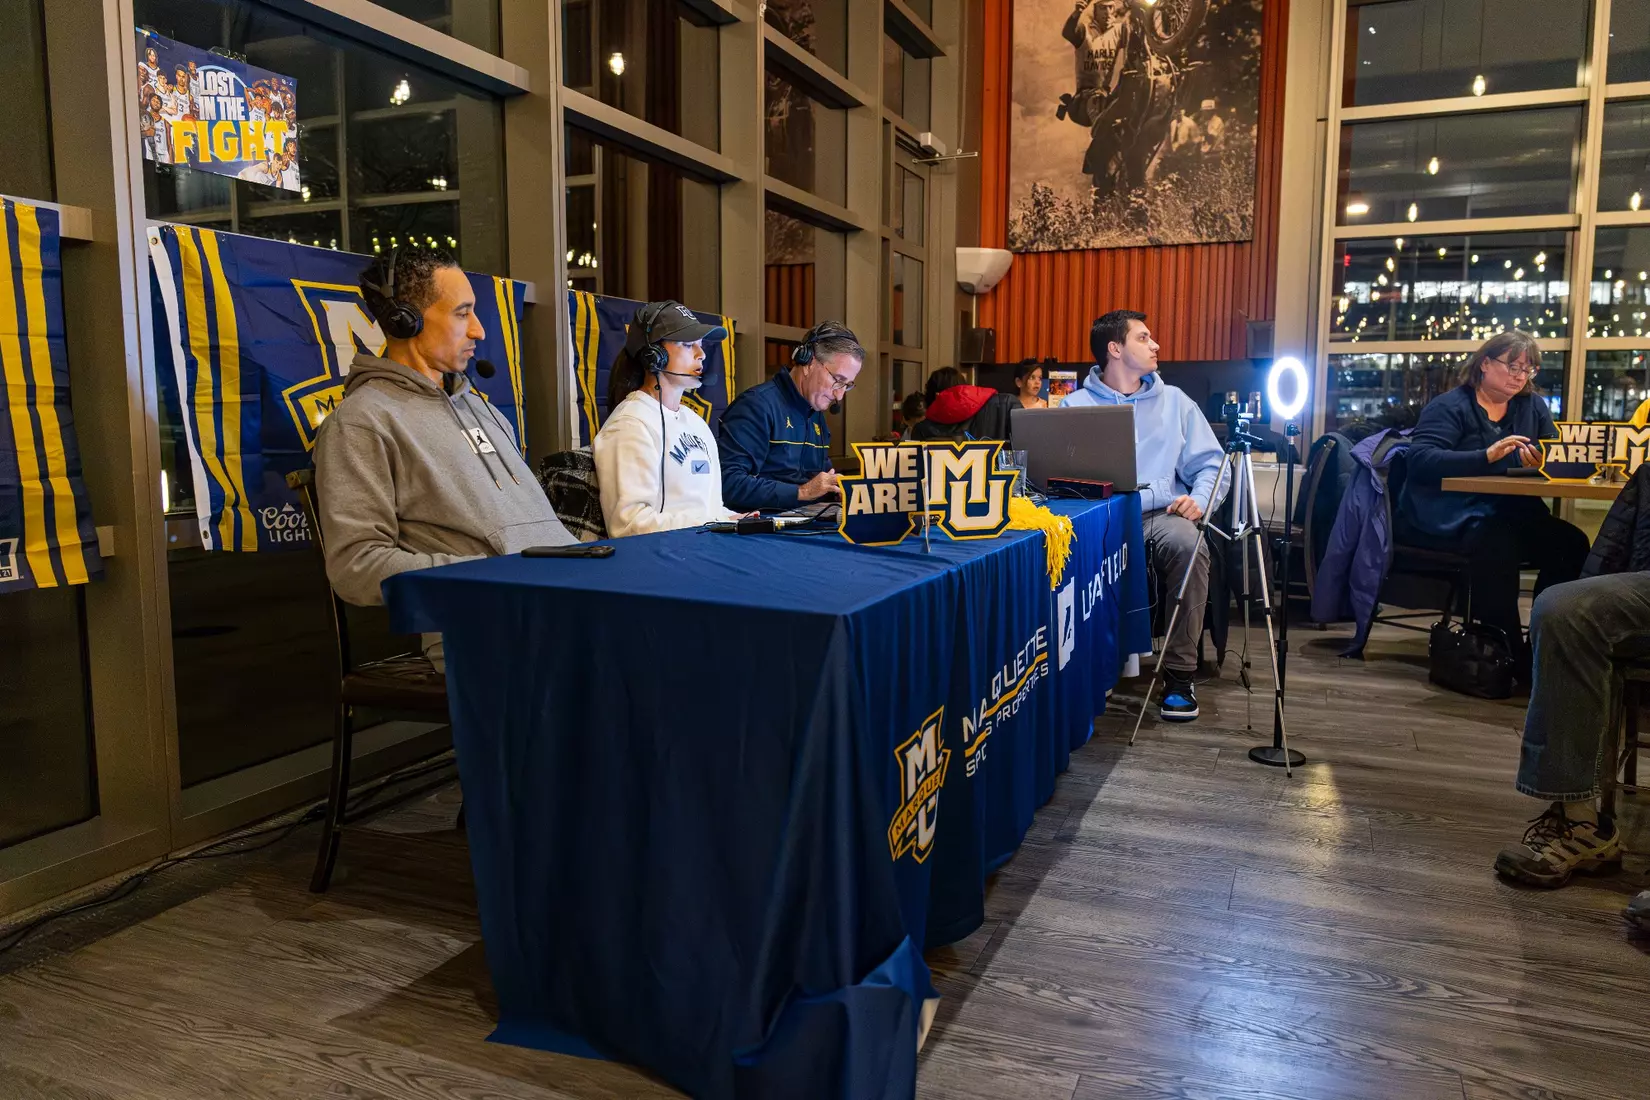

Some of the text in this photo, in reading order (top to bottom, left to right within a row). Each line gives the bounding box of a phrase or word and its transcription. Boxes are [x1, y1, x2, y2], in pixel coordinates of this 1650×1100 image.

[198, 71, 235, 96] LOST
[198, 97, 246, 120] IN THE
[171, 120, 288, 163] FIGHT
[1560, 425, 1606, 443] WE
[861, 448, 917, 479] WE
[1546, 445, 1604, 463] ARE
[848, 482, 917, 515] ARE
[929, 449, 1006, 532] MU
